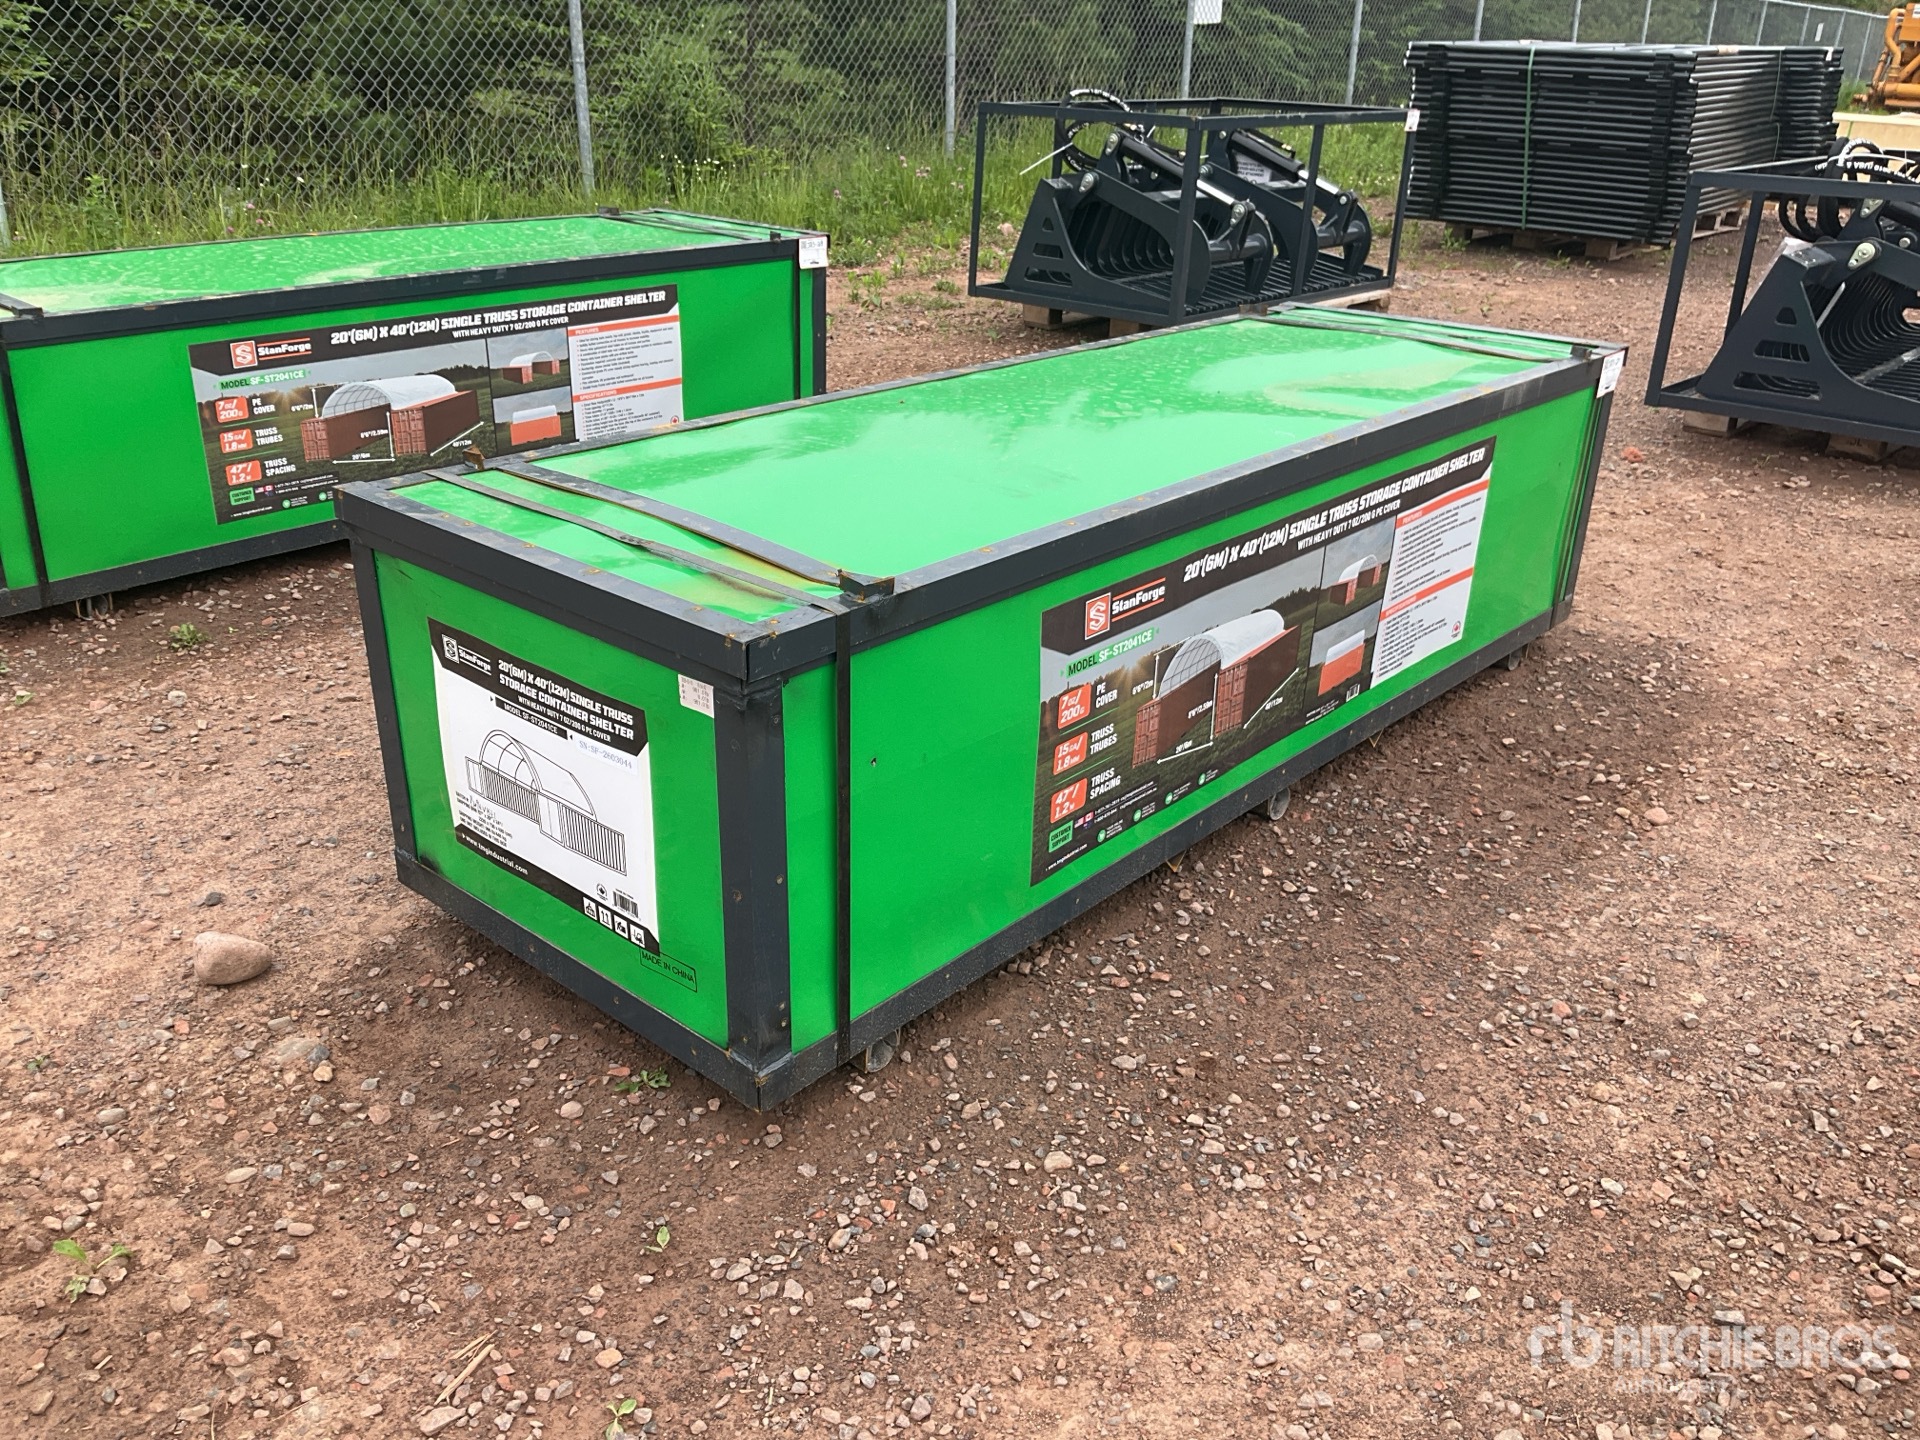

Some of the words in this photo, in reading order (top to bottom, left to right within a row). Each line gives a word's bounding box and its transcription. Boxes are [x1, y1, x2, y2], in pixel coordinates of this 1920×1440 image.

[331, 326, 377, 345] 20'(6M)
[380, 328, 389, 338] X
[390, 318, 439, 337] 40'(12M)
[441, 314, 482, 329] SINGLE
[483, 310, 518, 324] TRUSS
[520, 303, 566, 320] STORAGE
[568, 296, 623, 313] CONTAINER
[624, 291, 666, 305] SHELTER
[452, 328, 470, 338] WITH
[470, 326, 492, 336] HEAVY
[493, 324, 508, 334] DUTY
[542, 318, 549, 326] PE
[550, 316, 569, 325] COVER
[258, 342, 312, 356] StanForge
[221, 379, 249, 390] MODEL
[250, 370, 304, 385] SF-ST2041CE
[252, 398, 261, 407] PE
[254, 405, 275, 415] COVER
[255, 427, 278, 437] TRUSS
[256, 434, 283, 446] TRUBES
[264, 457, 287, 468] TRUSS
[266, 464, 296, 477] SPACING
[1183, 547, 1229, 582] 20'(6M)
[1229, 545, 1240, 563] X
[1240, 523, 1289, 557] 40'(12M)
[1289, 509, 1329, 539] SINGLE
[1328, 498, 1360, 524] TRUSS
[1359, 480, 1402, 510] STORAGE
[1401, 461, 1449, 493] CONTAINER
[1449, 447, 1486, 473] SHELTER
[1297, 536, 1313, 550] WITH
[1313, 528, 1333, 543] HEAVY
[1333, 522, 1348, 536] DUTY
[1376, 506, 1384, 518] PE
[1384, 499, 1401, 514] COVER
[1112, 586, 1166, 615] StanForge
[1068, 654, 1097, 676] MODEL
[1098, 629, 1153, 663] SF-ST2041CE
[498, 660, 527, 683] 20'(6M)
[527, 674, 534, 684] X
[535, 676, 570, 702] 40'(12M)
[570, 692, 601, 713] SINGLE
[602, 705, 633, 725] TRUSS
[1095, 689, 1118, 708] COVER
[1096, 682, 1106, 695] PE
[499, 674, 537, 699] STORAGE
[538, 689, 588, 722] CONTAINER
[589, 713, 634, 740] SHELTER
[504, 702, 522, 717] MODEL
[522, 712, 558, 734] SF-ST2041CE
[593, 729, 611, 742] COVER
[1091, 723, 1114, 743] TRUSS
[1090, 733, 1118, 755] TRUBES
[1089, 775, 1121, 800] SPACING
[1091, 767, 1115, 787] TRUSS
[465, 835, 529, 875] www.tmgindustrial.com
[641, 950, 662, 967] MADE
[663, 960, 671, 971] IN
[672, 966, 694, 983] CHINA
